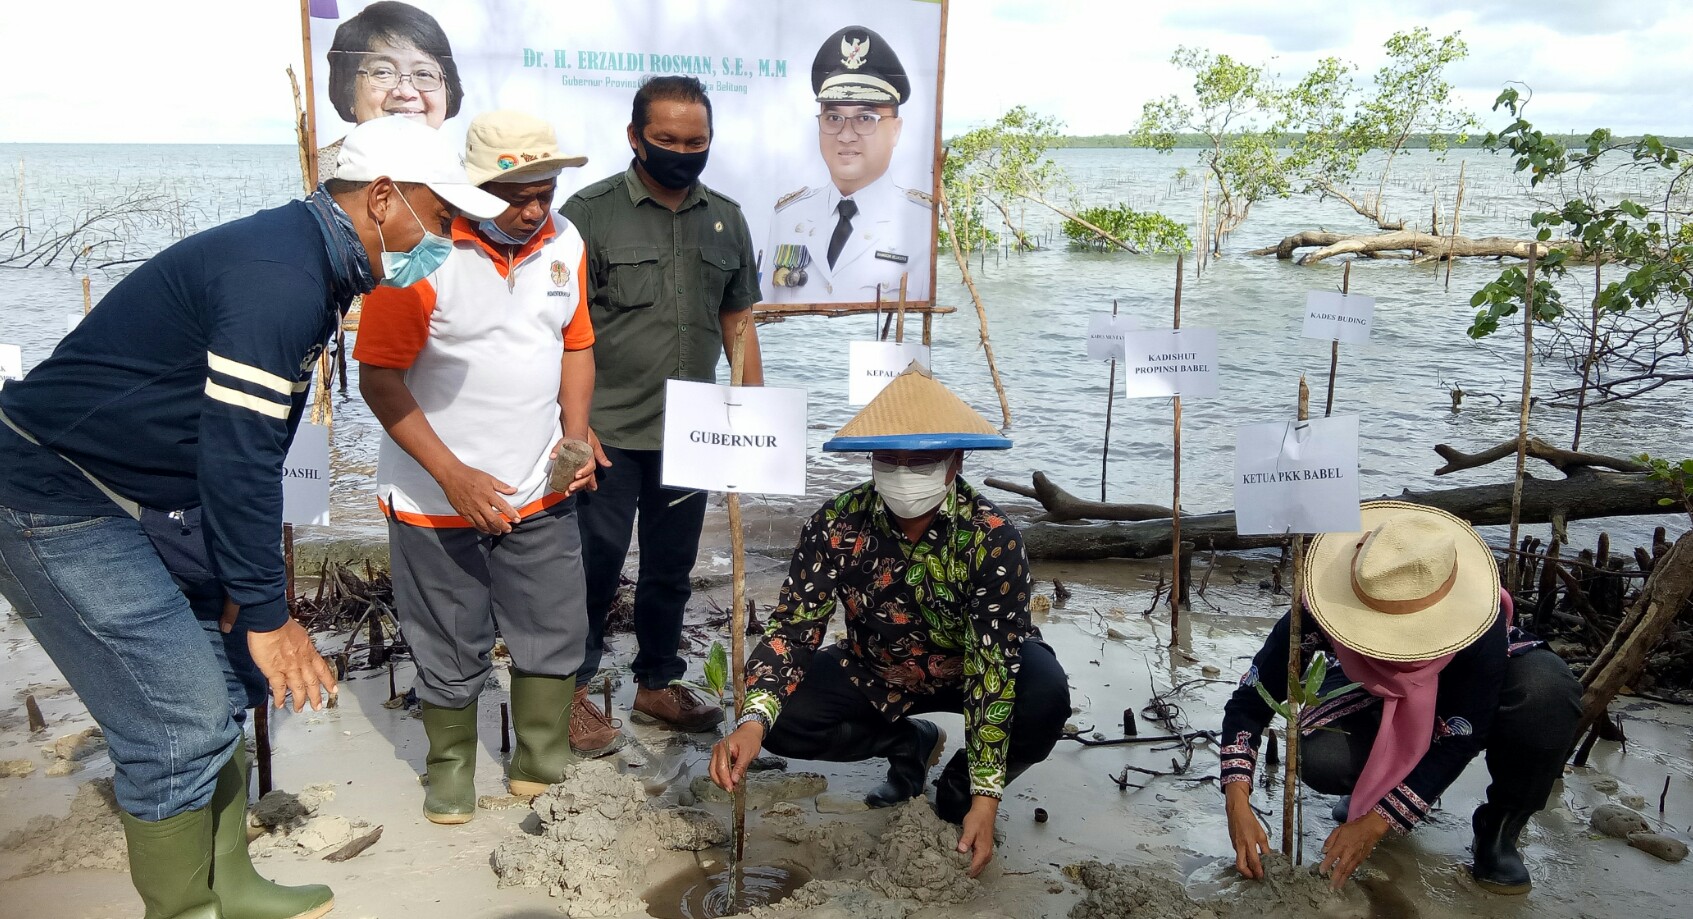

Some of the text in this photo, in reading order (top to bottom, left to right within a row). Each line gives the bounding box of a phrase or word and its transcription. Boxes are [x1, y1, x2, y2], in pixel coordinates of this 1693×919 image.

[523, 48, 787, 78] Dr. H. ERZALDI ROSMAN, S.E., M.M
[562, 75, 602, 87] Gubernur
[716, 82, 748, 95] Belitung
[1310, 312, 1367, 326] KADES BUDING
[1148, 352, 1196, 362] KADISHUT
[1135, 364, 1210, 374] PROPINSI BABEL
[689, 429, 778, 448] GUBERNUR
[1242, 467, 1344, 485] KETUA PKK BABEL
